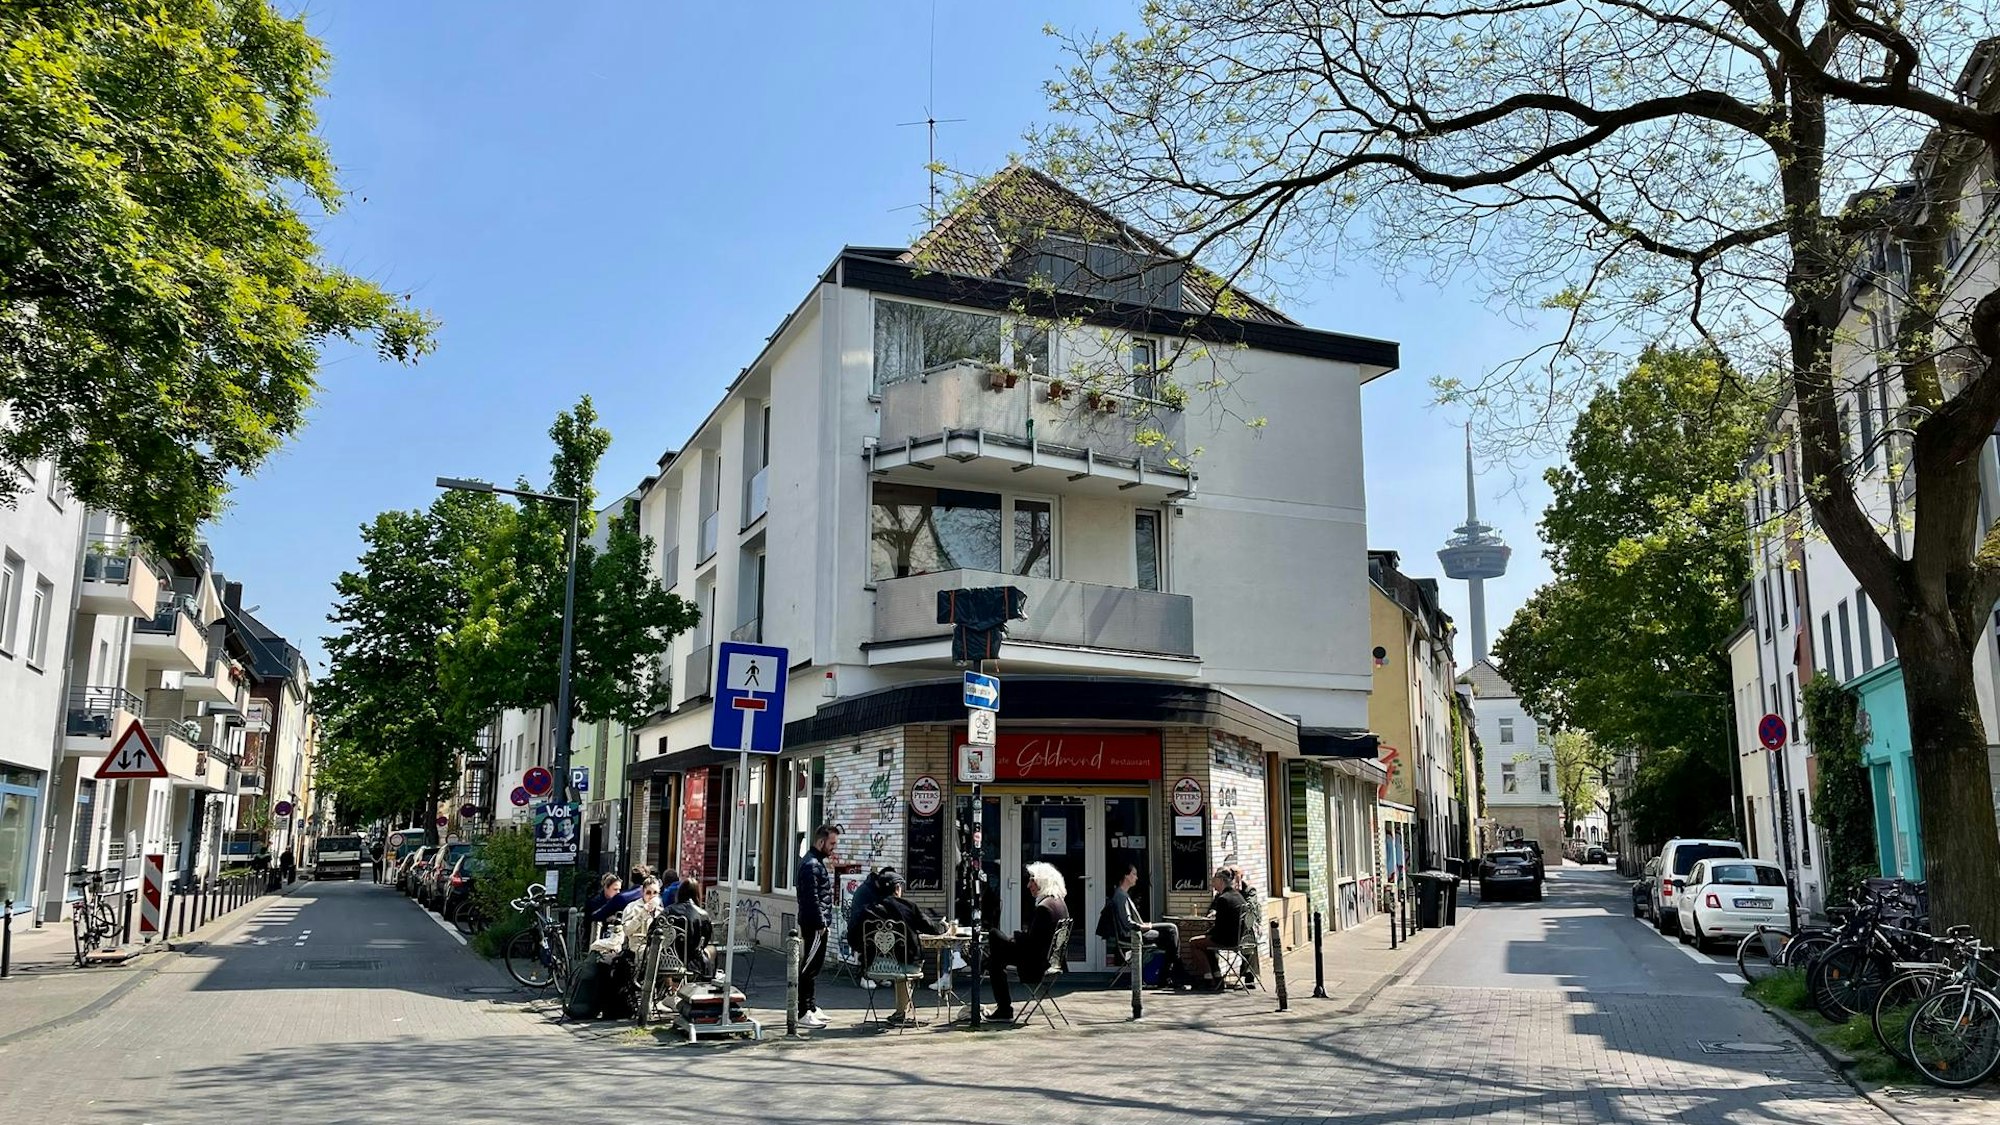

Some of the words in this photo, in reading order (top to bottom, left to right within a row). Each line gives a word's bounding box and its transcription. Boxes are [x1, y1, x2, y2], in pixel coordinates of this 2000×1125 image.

[1016, 739, 1104, 777] Goldmund
[1110, 757, 1150, 766] Restaurant
[572, 771, 583, 788] P
[913, 791, 939, 799] PETERS
[1175, 793, 1200, 801] PETERS
[546, 805, 572, 818] Volt
